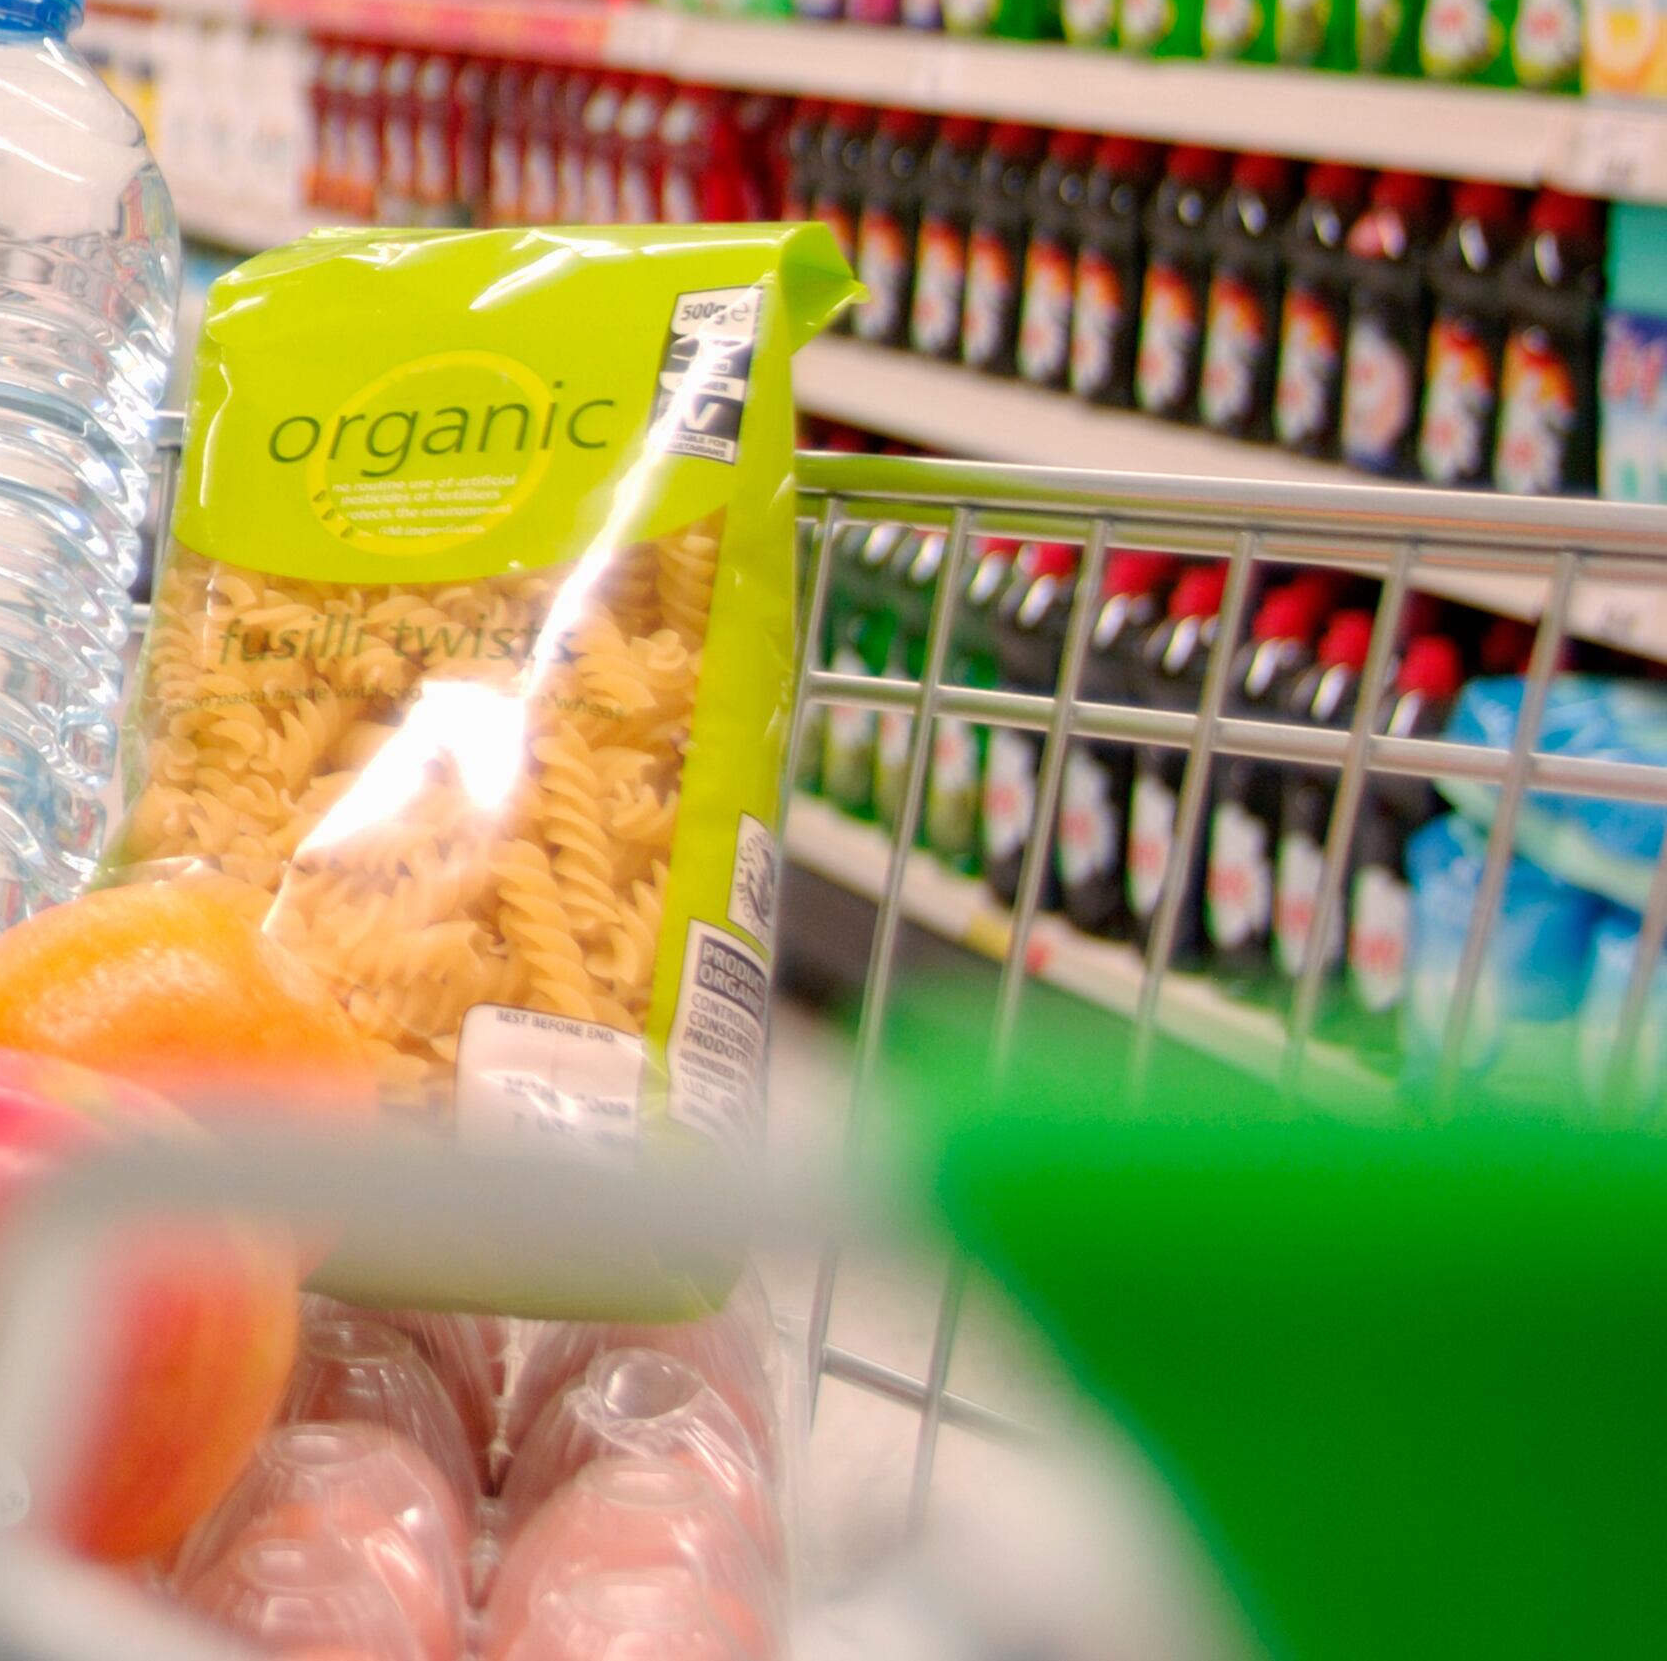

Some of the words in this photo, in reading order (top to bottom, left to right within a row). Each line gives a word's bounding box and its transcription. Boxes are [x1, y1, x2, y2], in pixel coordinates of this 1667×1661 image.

[268, 380, 614, 478] organic
[408, 479, 433, 489] use
[395, 505, 417, 518] the
[218, 613, 366, 666] fusilli
[496, 1009, 528, 1025] BEST
[531, 1016, 583, 1037] BEFORE
[586, 1027, 615, 1043] END
